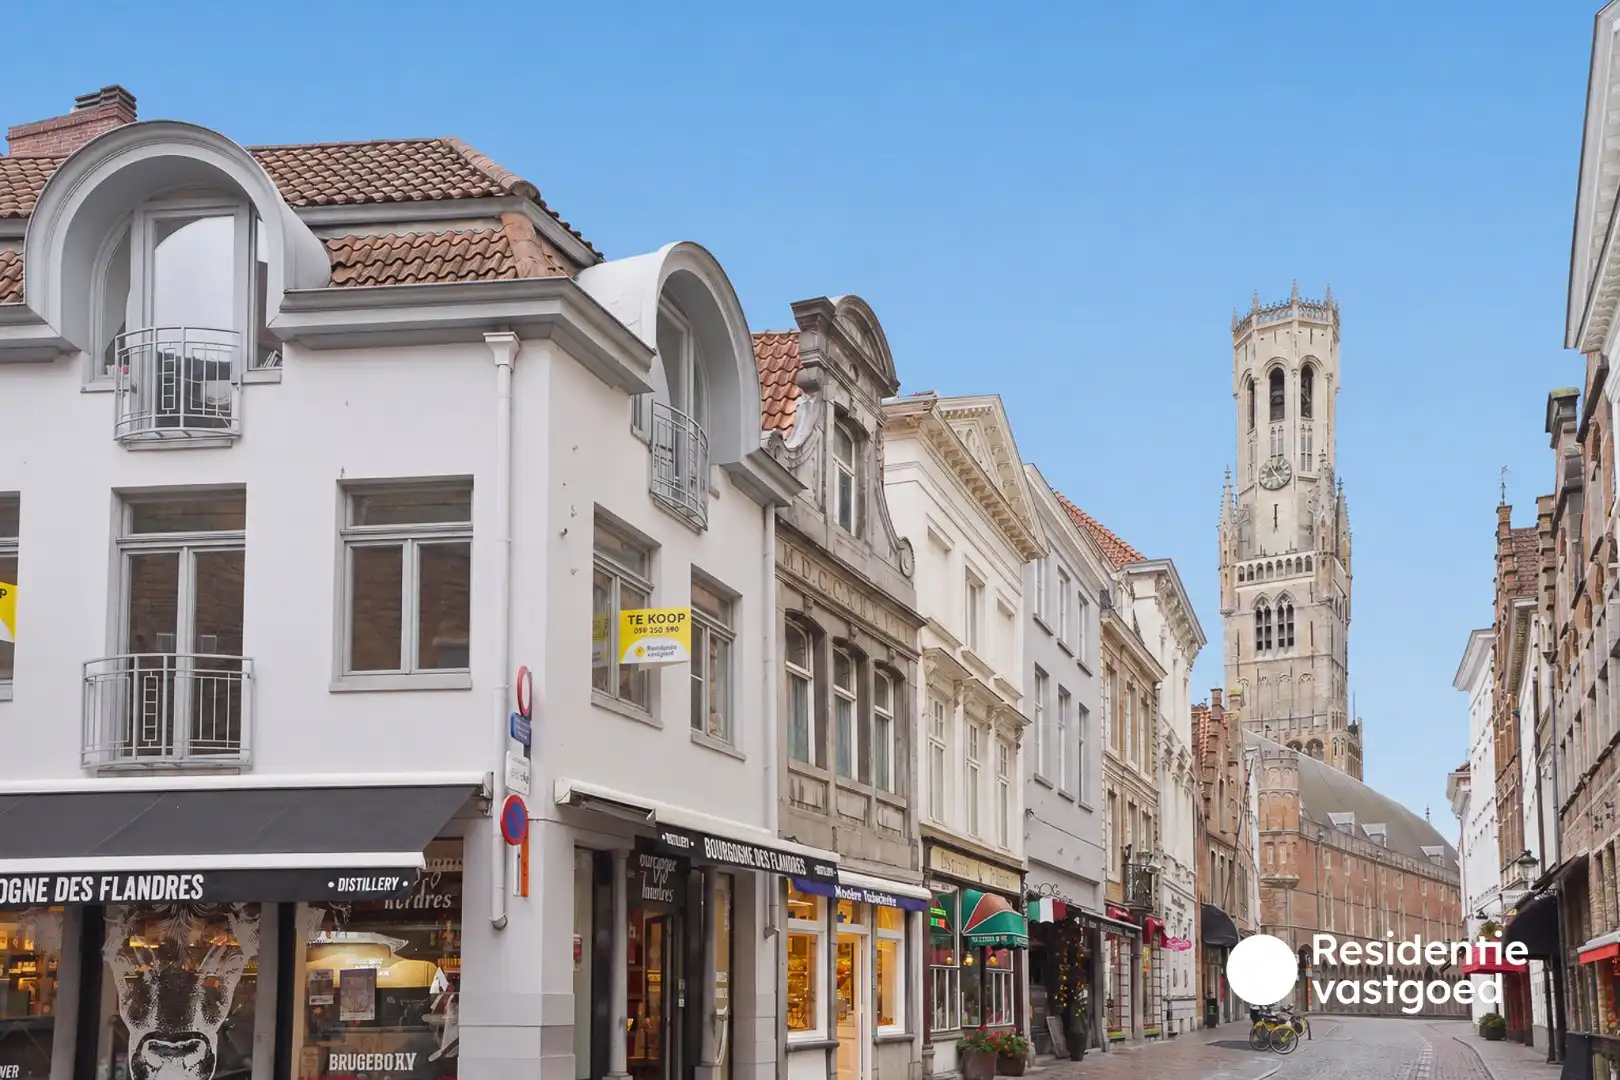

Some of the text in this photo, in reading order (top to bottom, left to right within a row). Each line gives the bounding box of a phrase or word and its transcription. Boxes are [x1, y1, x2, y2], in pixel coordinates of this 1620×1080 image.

[627, 613, 686, 625] TE KOOP
[704, 837, 807, 875] BOURGOGNE DES FLANDRES
[54, 876, 94, 902] DES
[100, 873, 205, 901] FLANDRES
[337, 877, 400, 892] DISTILLERY
